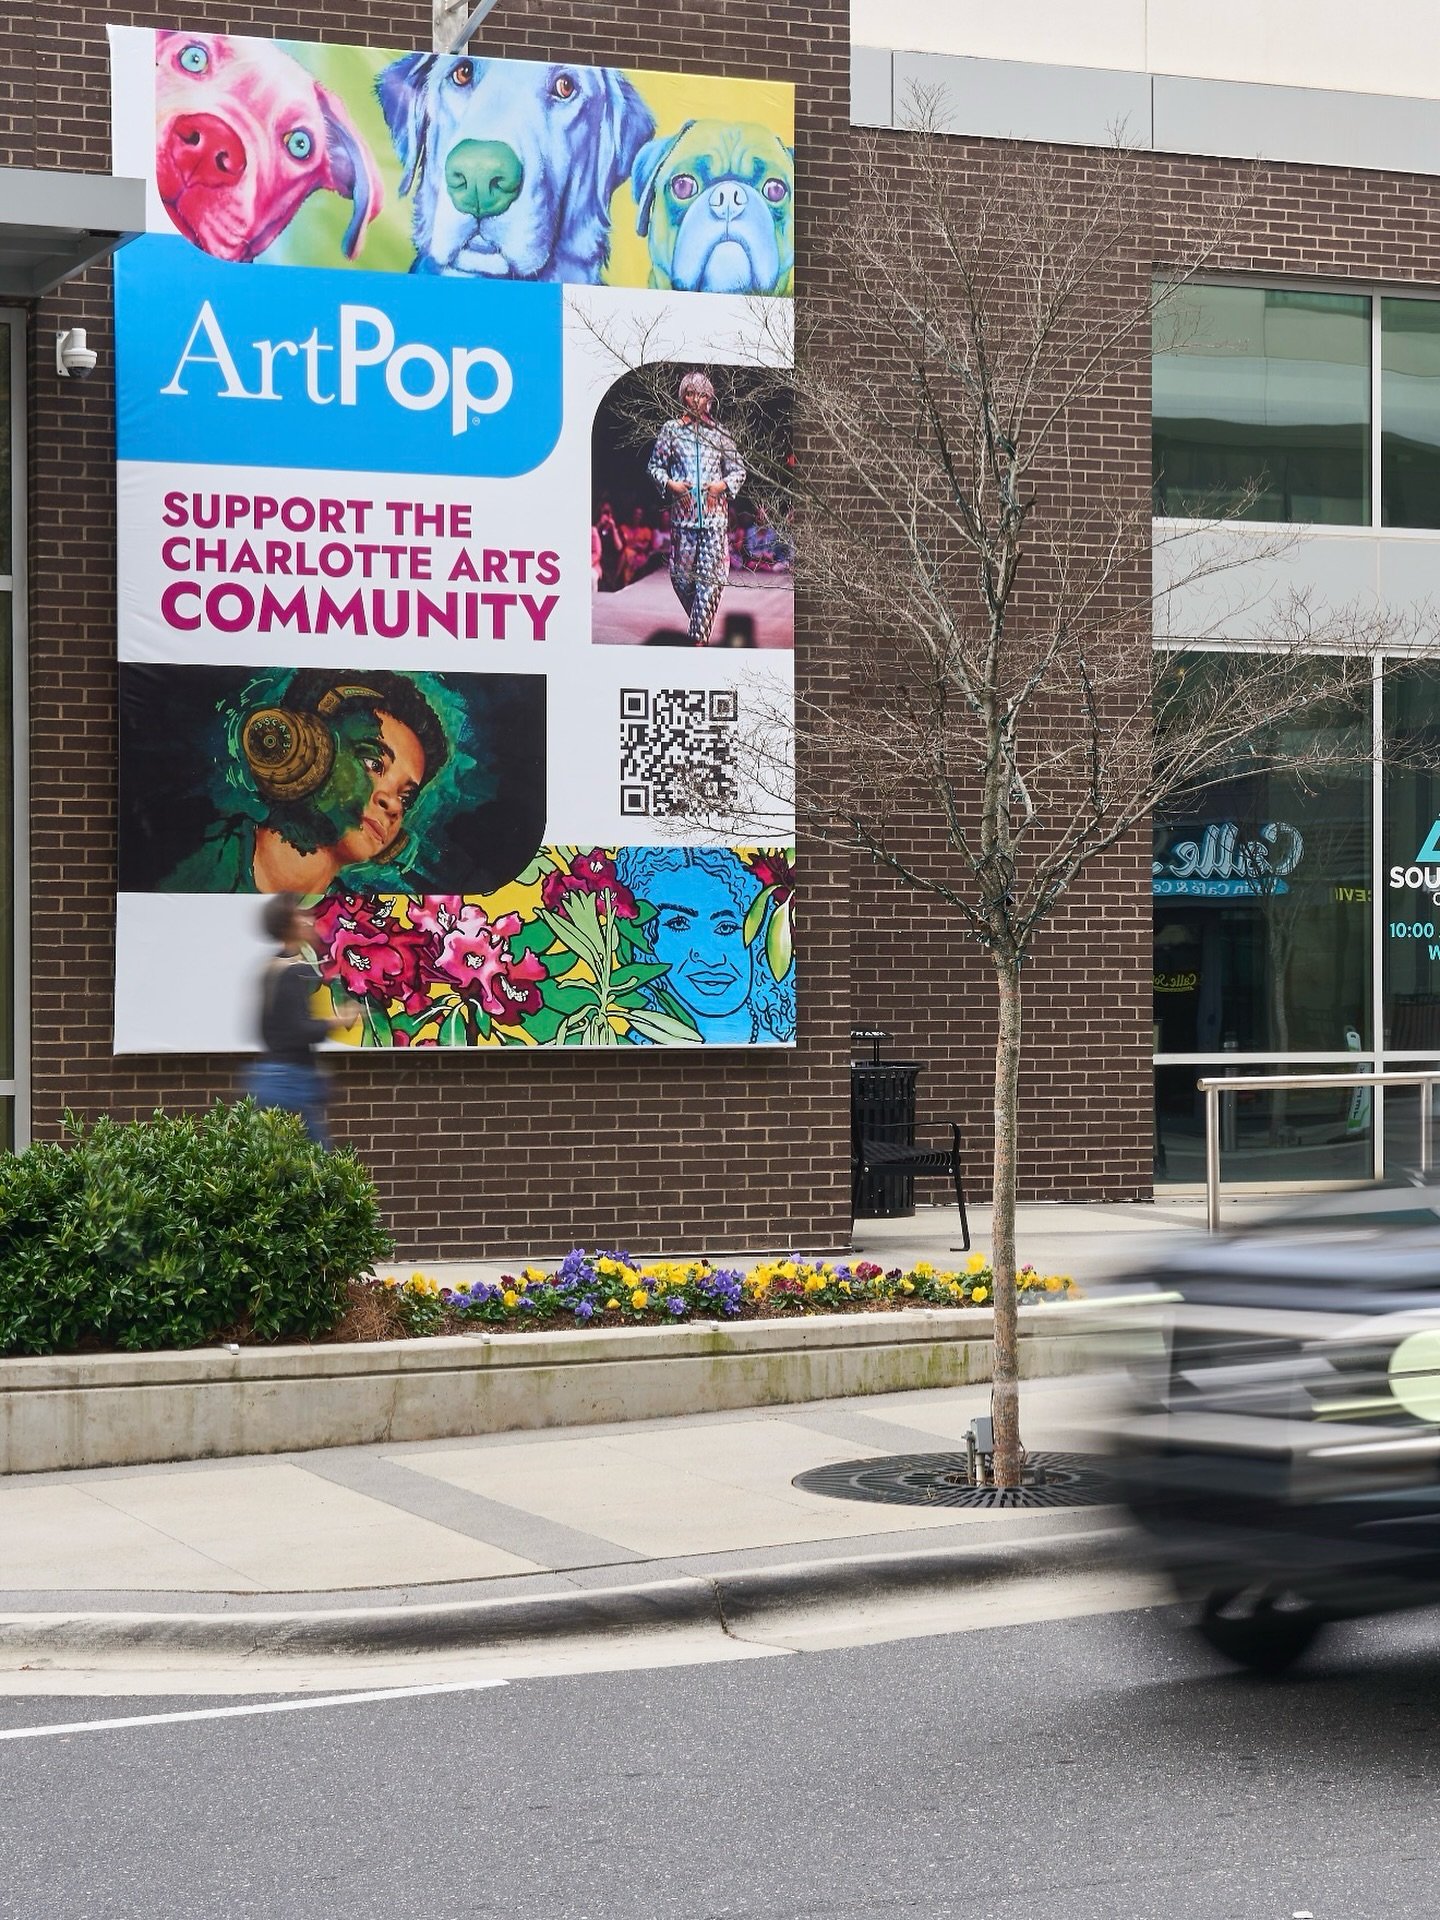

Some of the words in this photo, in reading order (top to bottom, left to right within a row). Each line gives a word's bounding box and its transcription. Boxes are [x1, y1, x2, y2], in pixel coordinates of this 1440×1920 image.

[160, 300, 513, 437] ArtPop
[161, 491, 373, 534] SUPPORT
[386, 501, 472, 538] THE
[161, 536, 432, 580] CHARLOTTE
[448, 546, 561, 586] ARTS
[160, 581, 560, 641] COMMUNITY
[1389, 922, 1434, 938] 10:00
